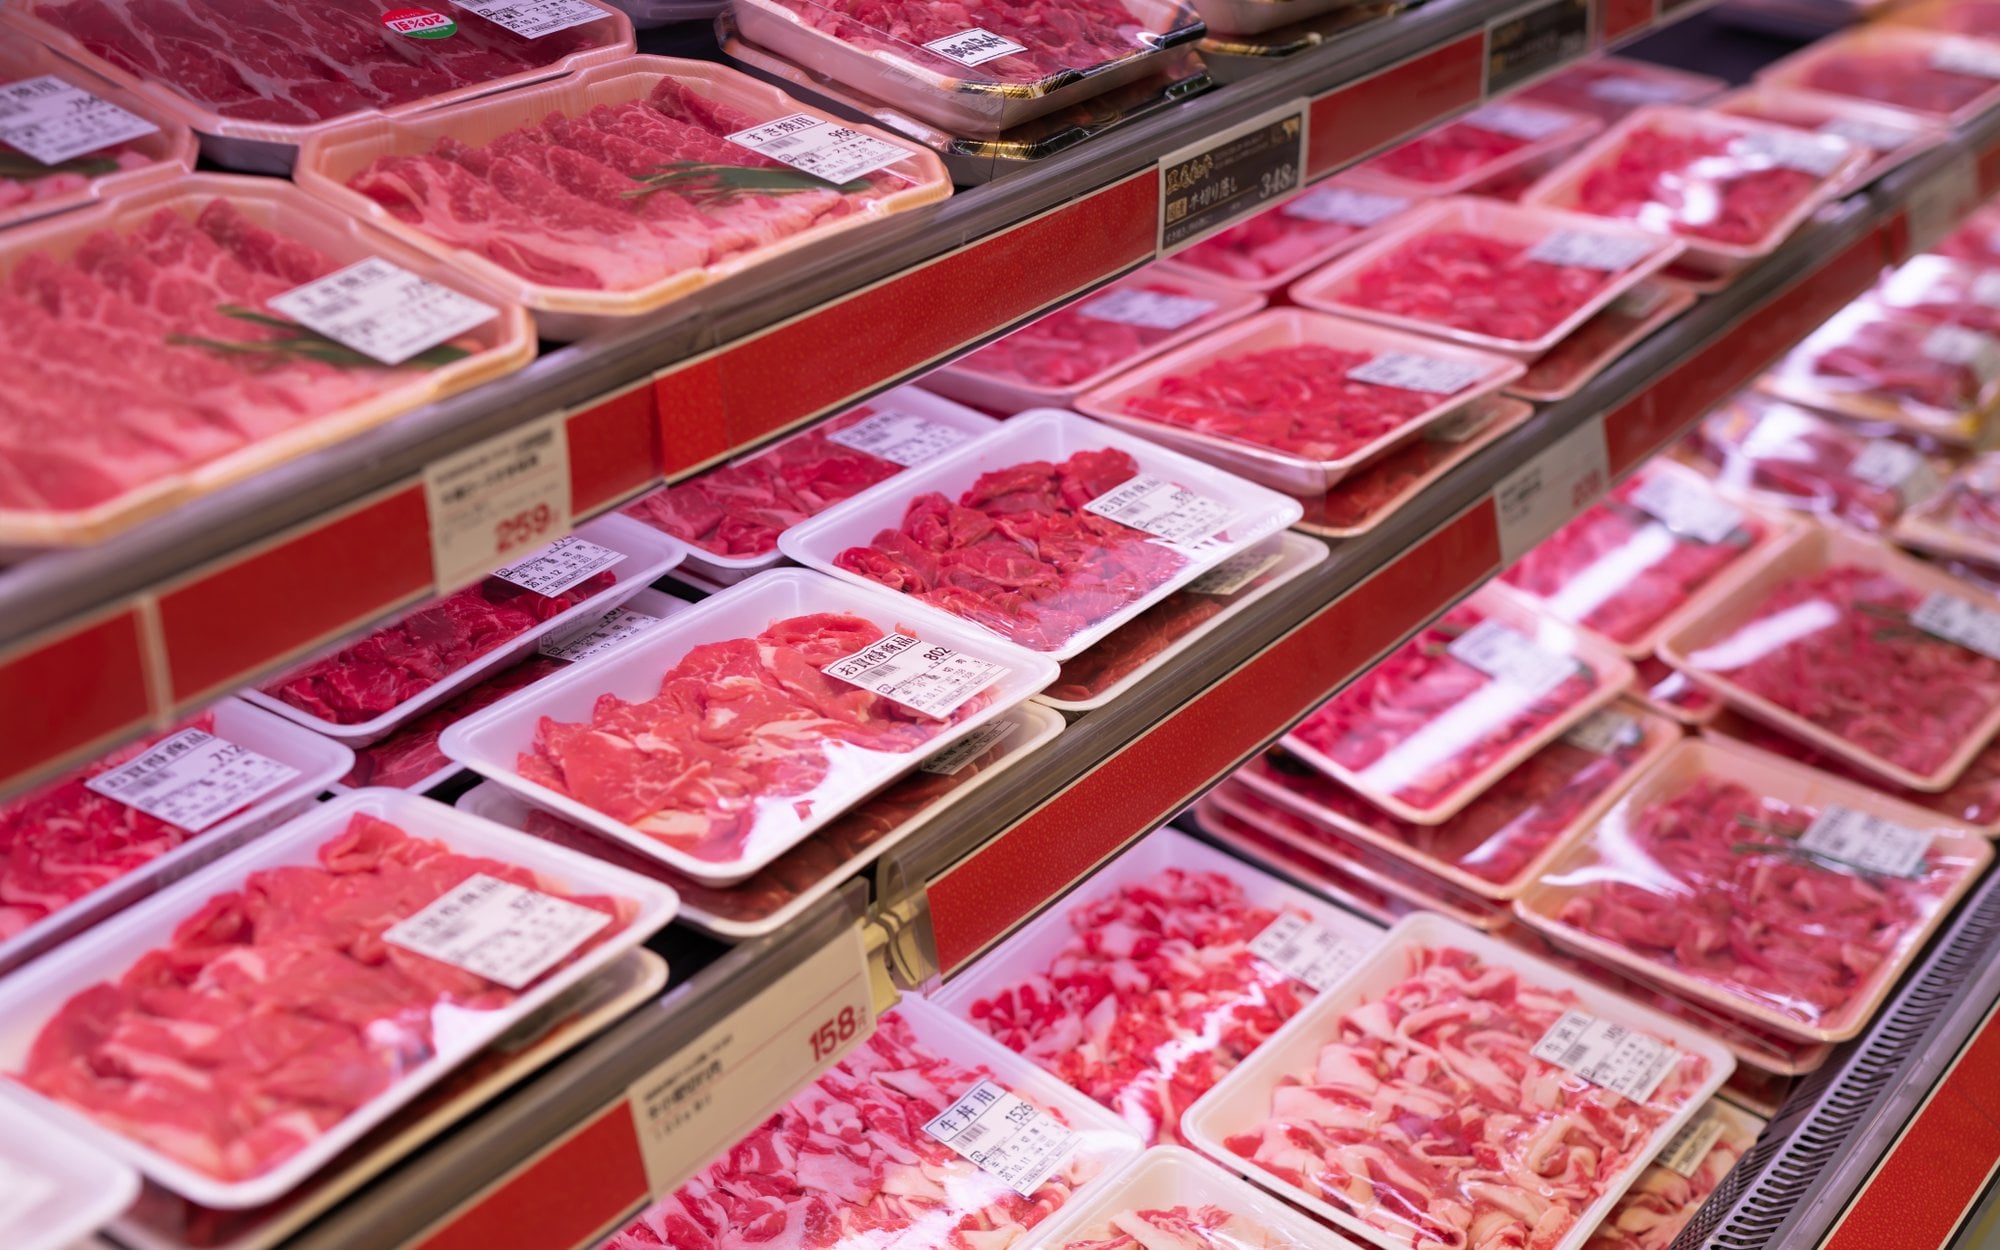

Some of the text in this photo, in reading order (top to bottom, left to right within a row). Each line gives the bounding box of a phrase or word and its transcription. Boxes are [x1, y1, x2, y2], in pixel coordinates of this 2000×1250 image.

[392, 15, 445, 32] 20%引
[745, 117, 816, 142] すき焼用
[1259, 163, 1293, 199] 348
[494, 503, 550, 553] 259
[529, 569, 562, 588] 20.10.12
[838, 637, 915, 676] お買得商品
[923, 647, 951, 661] 802
[209, 744, 244, 762] 712
[808, 1006, 857, 1062] 158
[939, 1088, 996, 1132] 牛丼用
[1005, 1102, 1034, 1124] 1526
[1001, 1157, 1032, 1182] 20.10.11
